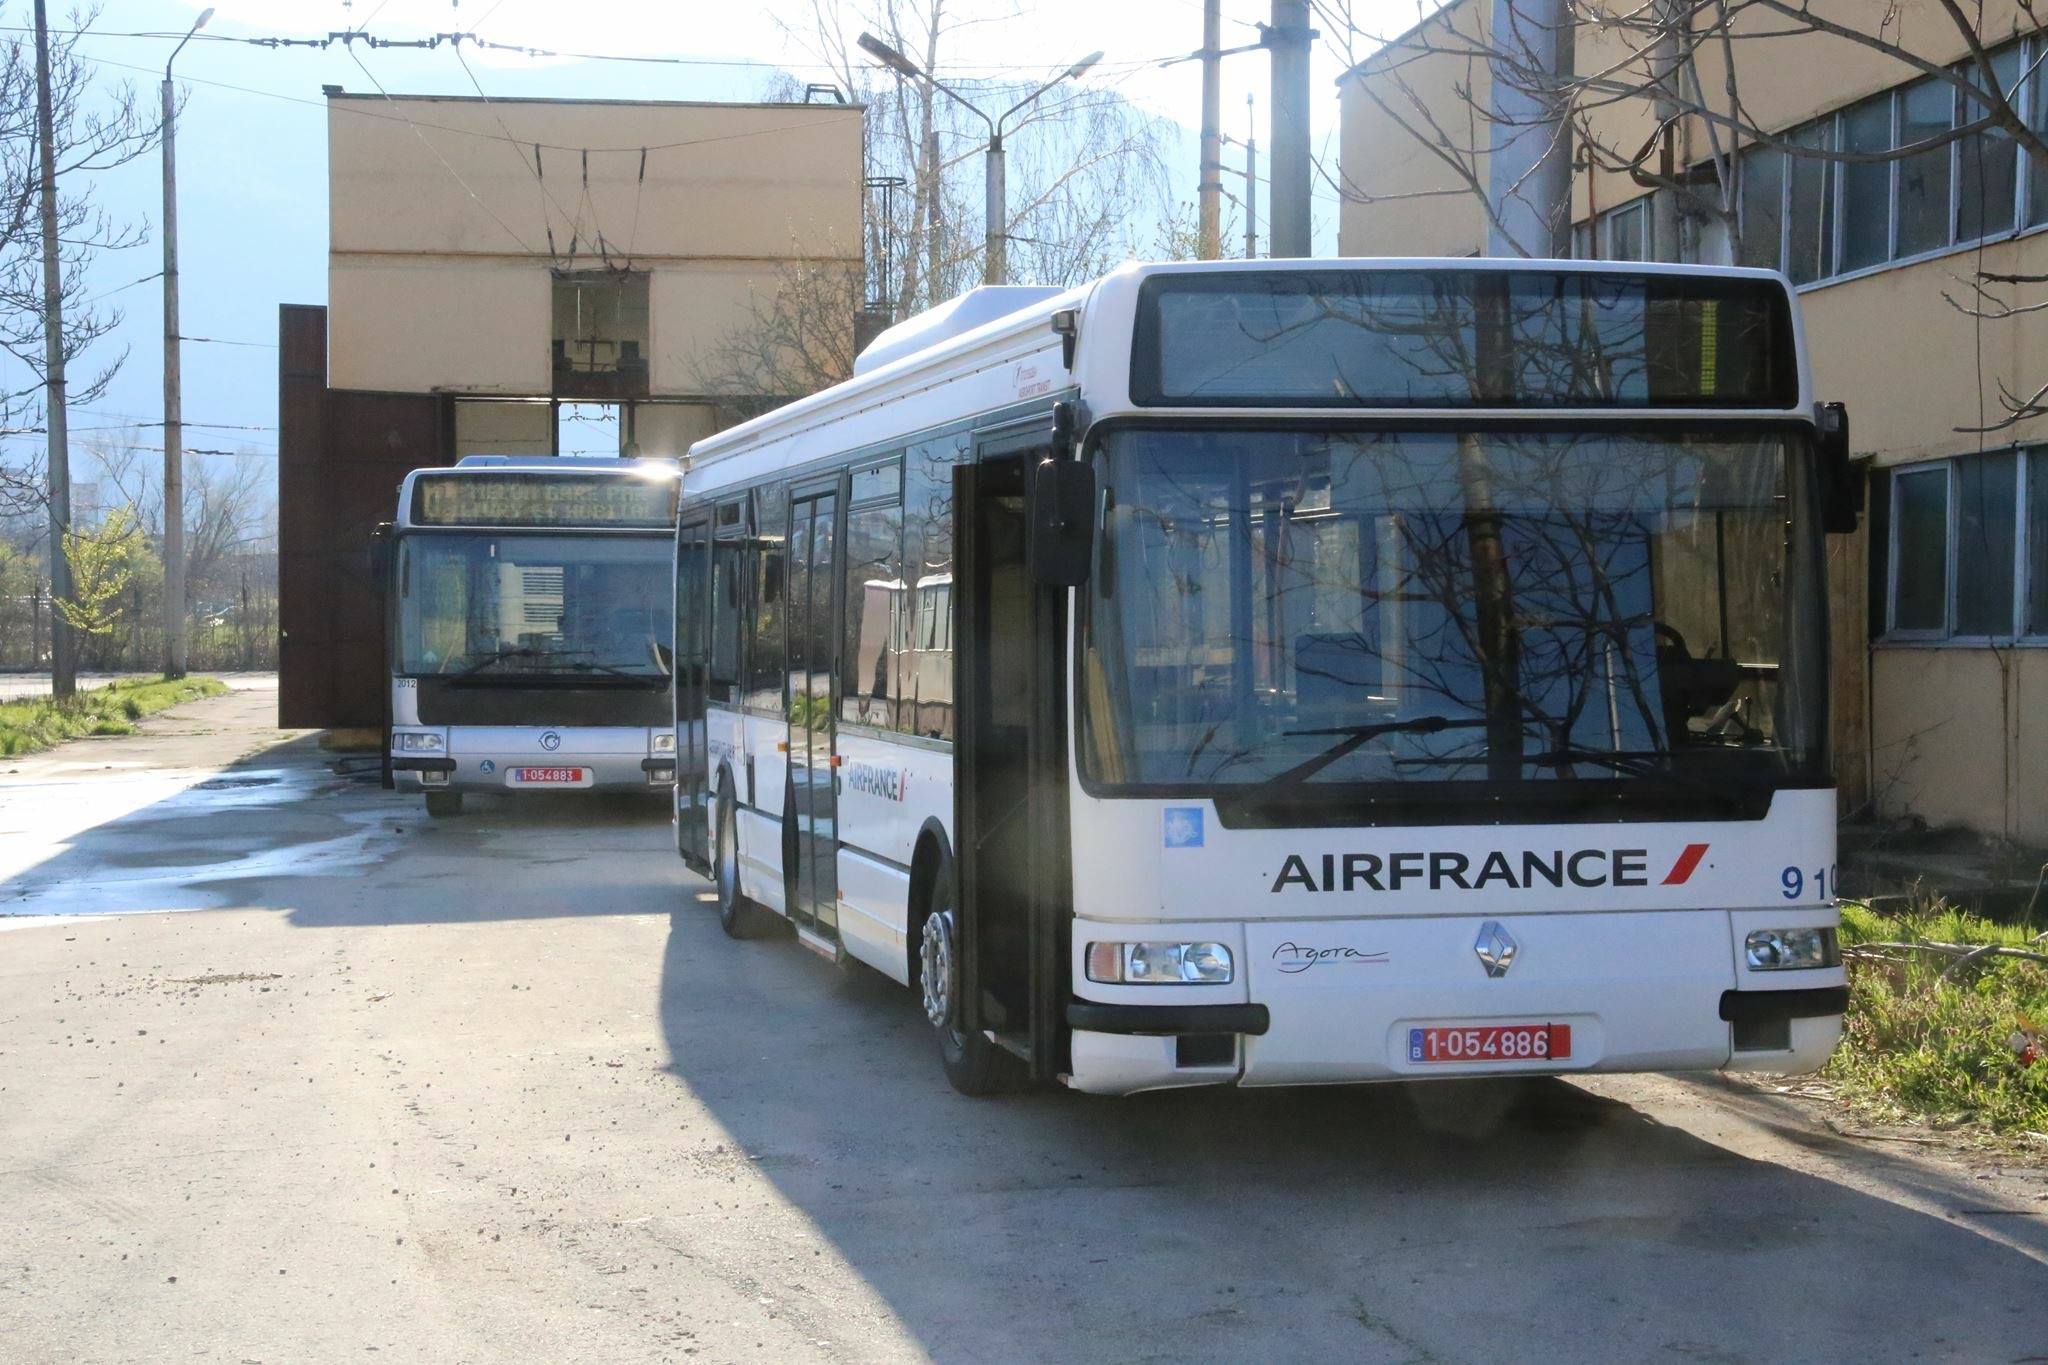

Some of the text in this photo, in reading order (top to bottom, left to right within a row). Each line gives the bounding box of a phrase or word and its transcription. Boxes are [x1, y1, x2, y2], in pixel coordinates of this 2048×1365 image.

[848, 761, 898, 802] AIRFRANCE
[1271, 849, 1648, 893] AIRFRANCE
[1272, 942, 1389, 974] Agora
[1412, 1030, 1548, 1058] B 1-054886
